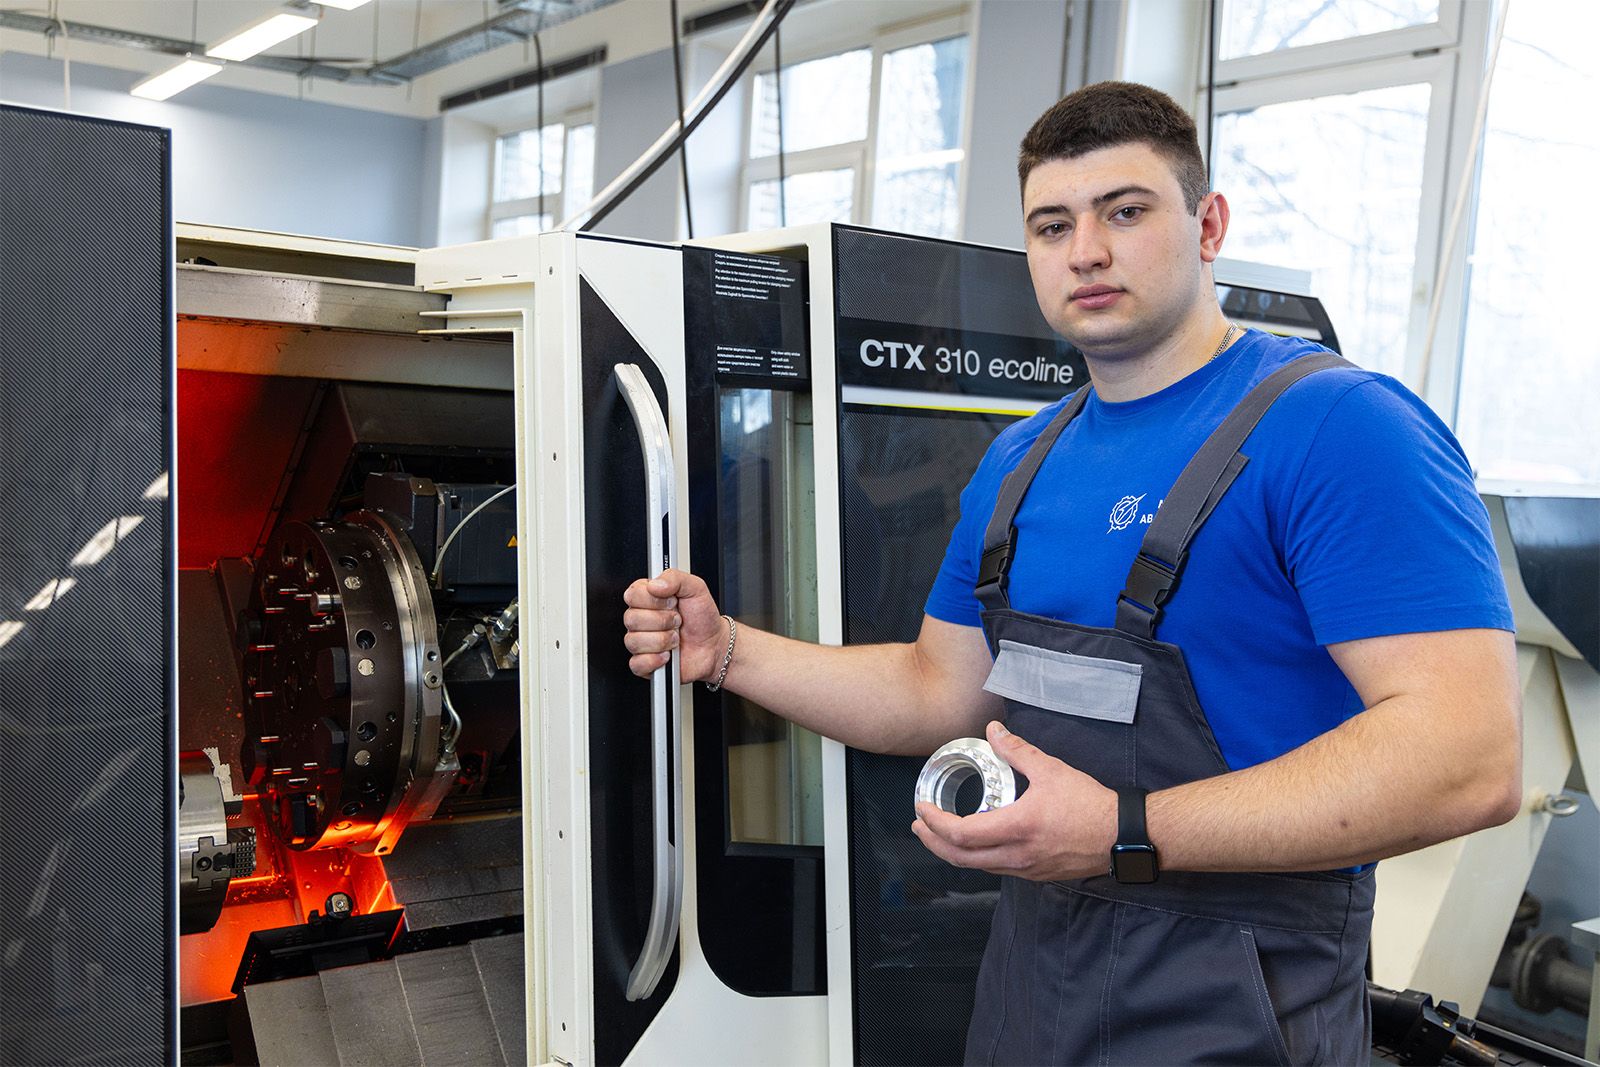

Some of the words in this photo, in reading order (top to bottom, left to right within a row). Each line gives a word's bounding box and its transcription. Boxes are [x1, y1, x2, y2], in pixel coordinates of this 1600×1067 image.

[860, 338, 926, 371] CTX
[935, 347, 980, 376] 310
[988, 356, 1074, 384] ecoline
